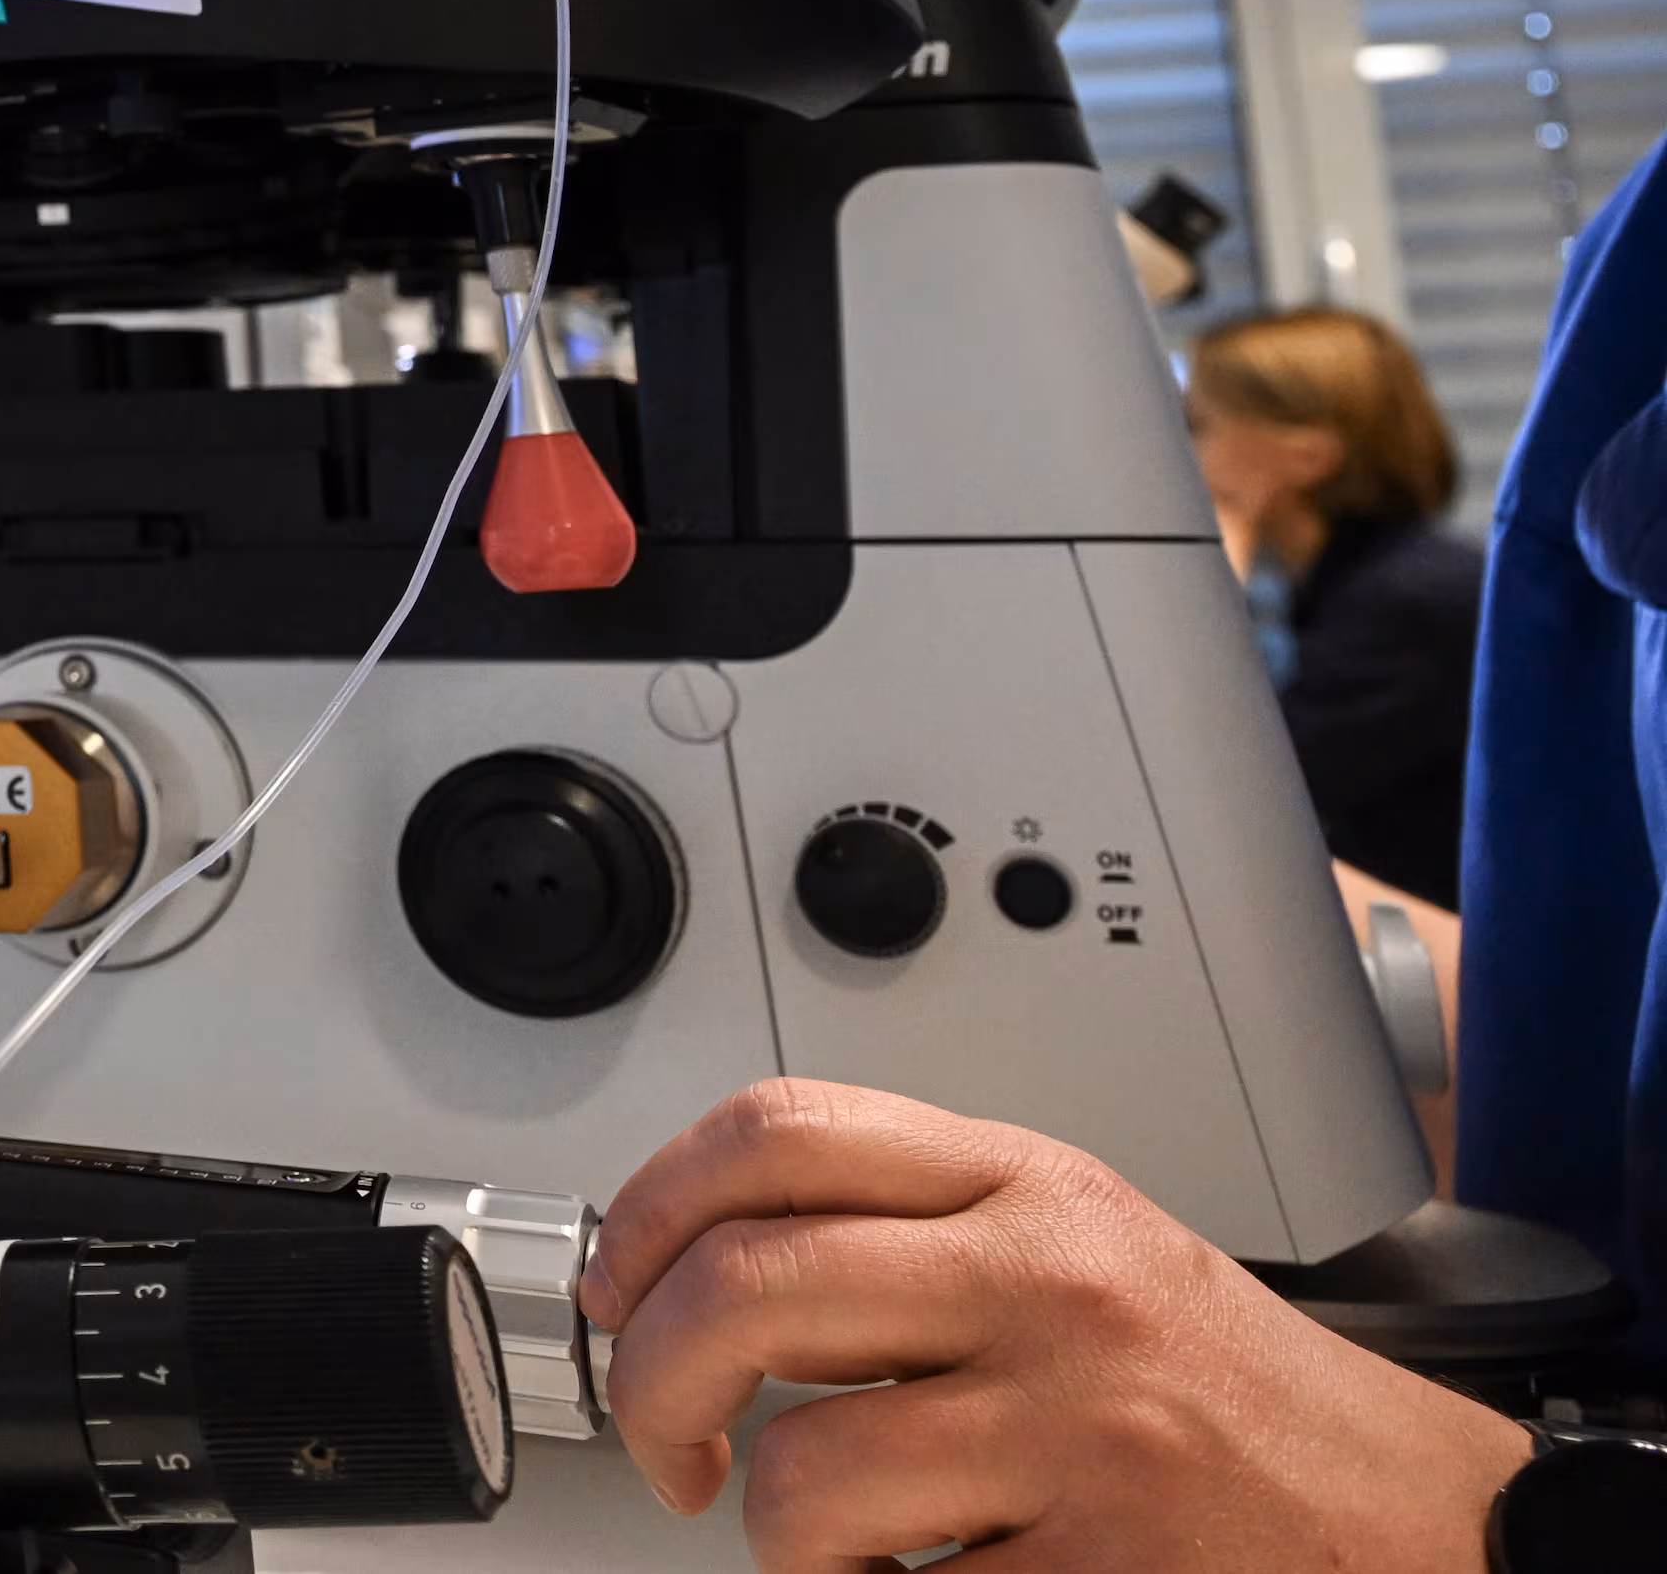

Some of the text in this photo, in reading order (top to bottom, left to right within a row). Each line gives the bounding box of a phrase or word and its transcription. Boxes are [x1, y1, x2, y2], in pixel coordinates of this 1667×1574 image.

[1096, 851, 1132, 869] ON
[1096, 905, 1143, 922] OFF
[134, 1283, 167, 1299] 3
[139, 1365, 170, 1386] 4
[156, 1452, 191, 1470] 5
